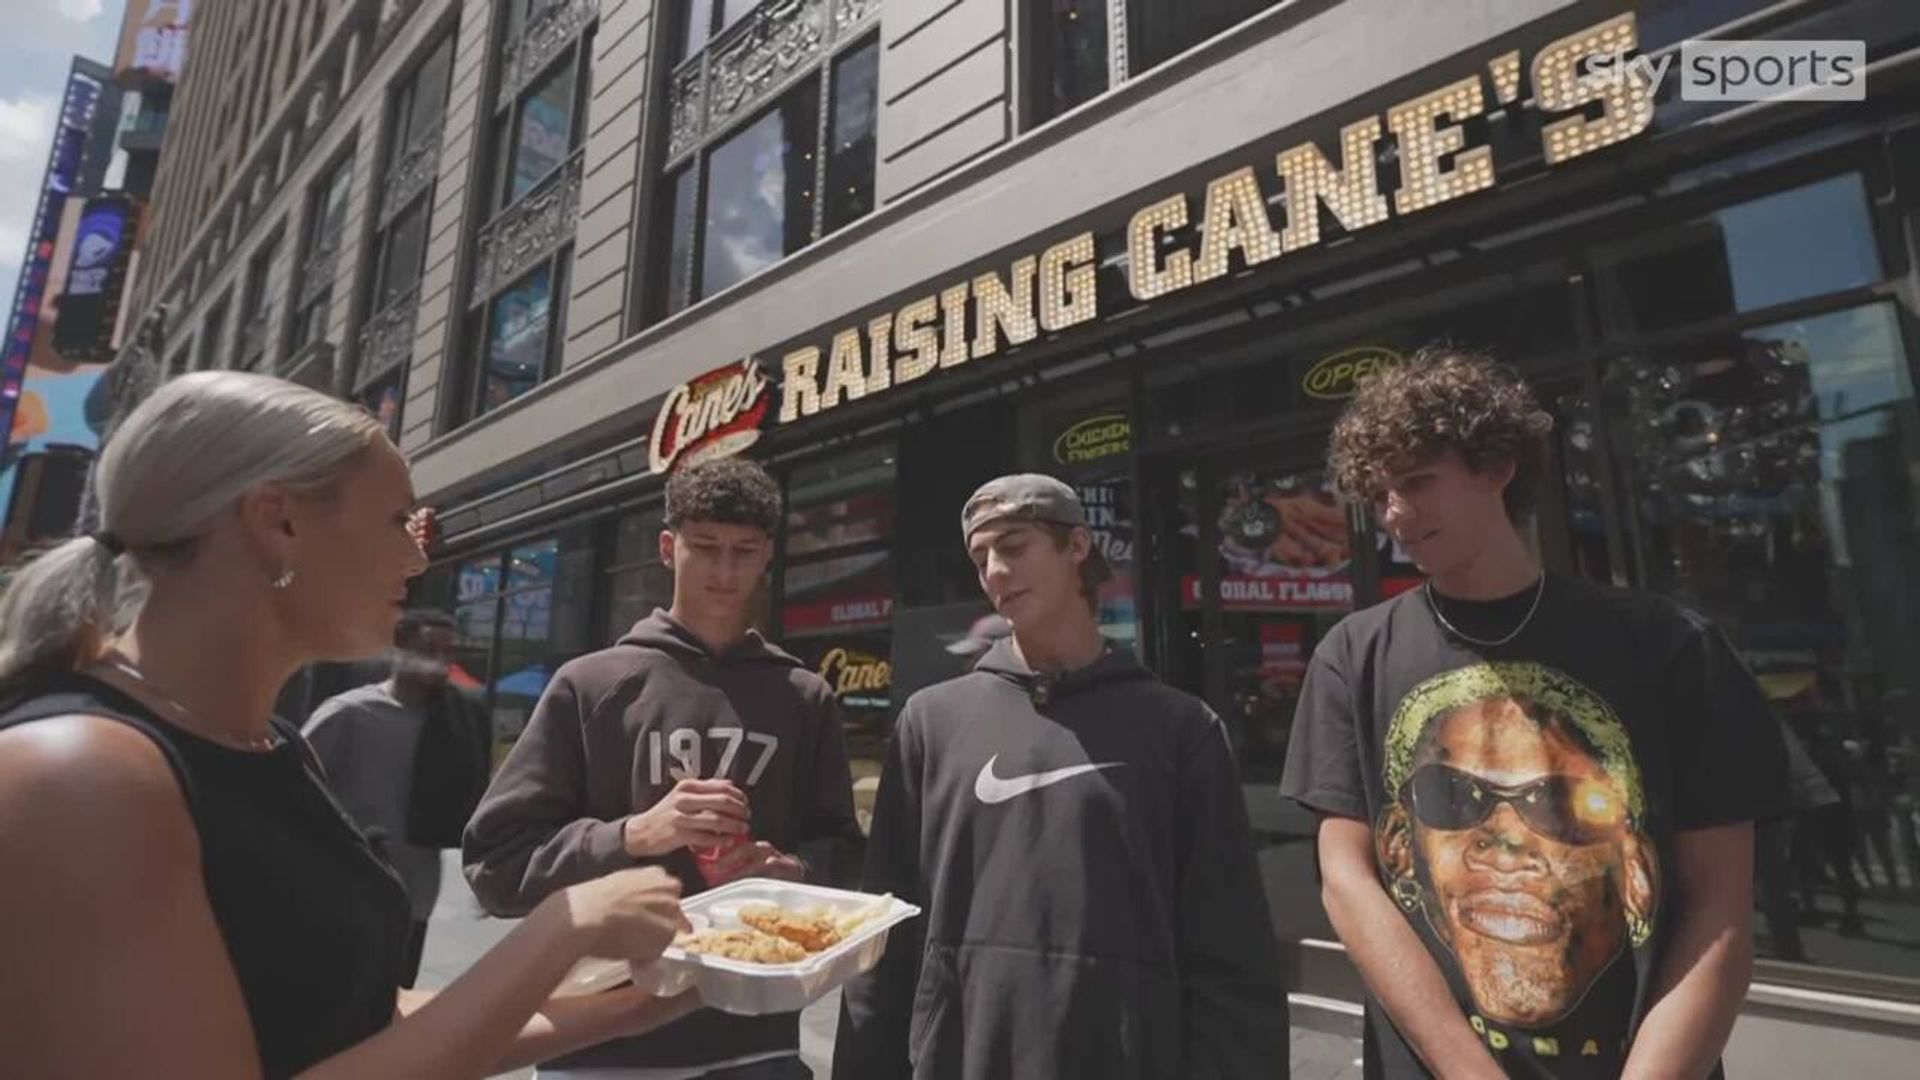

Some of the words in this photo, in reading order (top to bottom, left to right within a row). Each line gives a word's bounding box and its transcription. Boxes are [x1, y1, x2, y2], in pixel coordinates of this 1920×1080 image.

[779, 231, 1097, 423] RAISING
[1127, 10, 1655, 300] CANE'S
[649, 356, 767, 474] Cane's
[1311, 357, 1392, 391] OPEN
[649, 727, 779, 786] 1977
